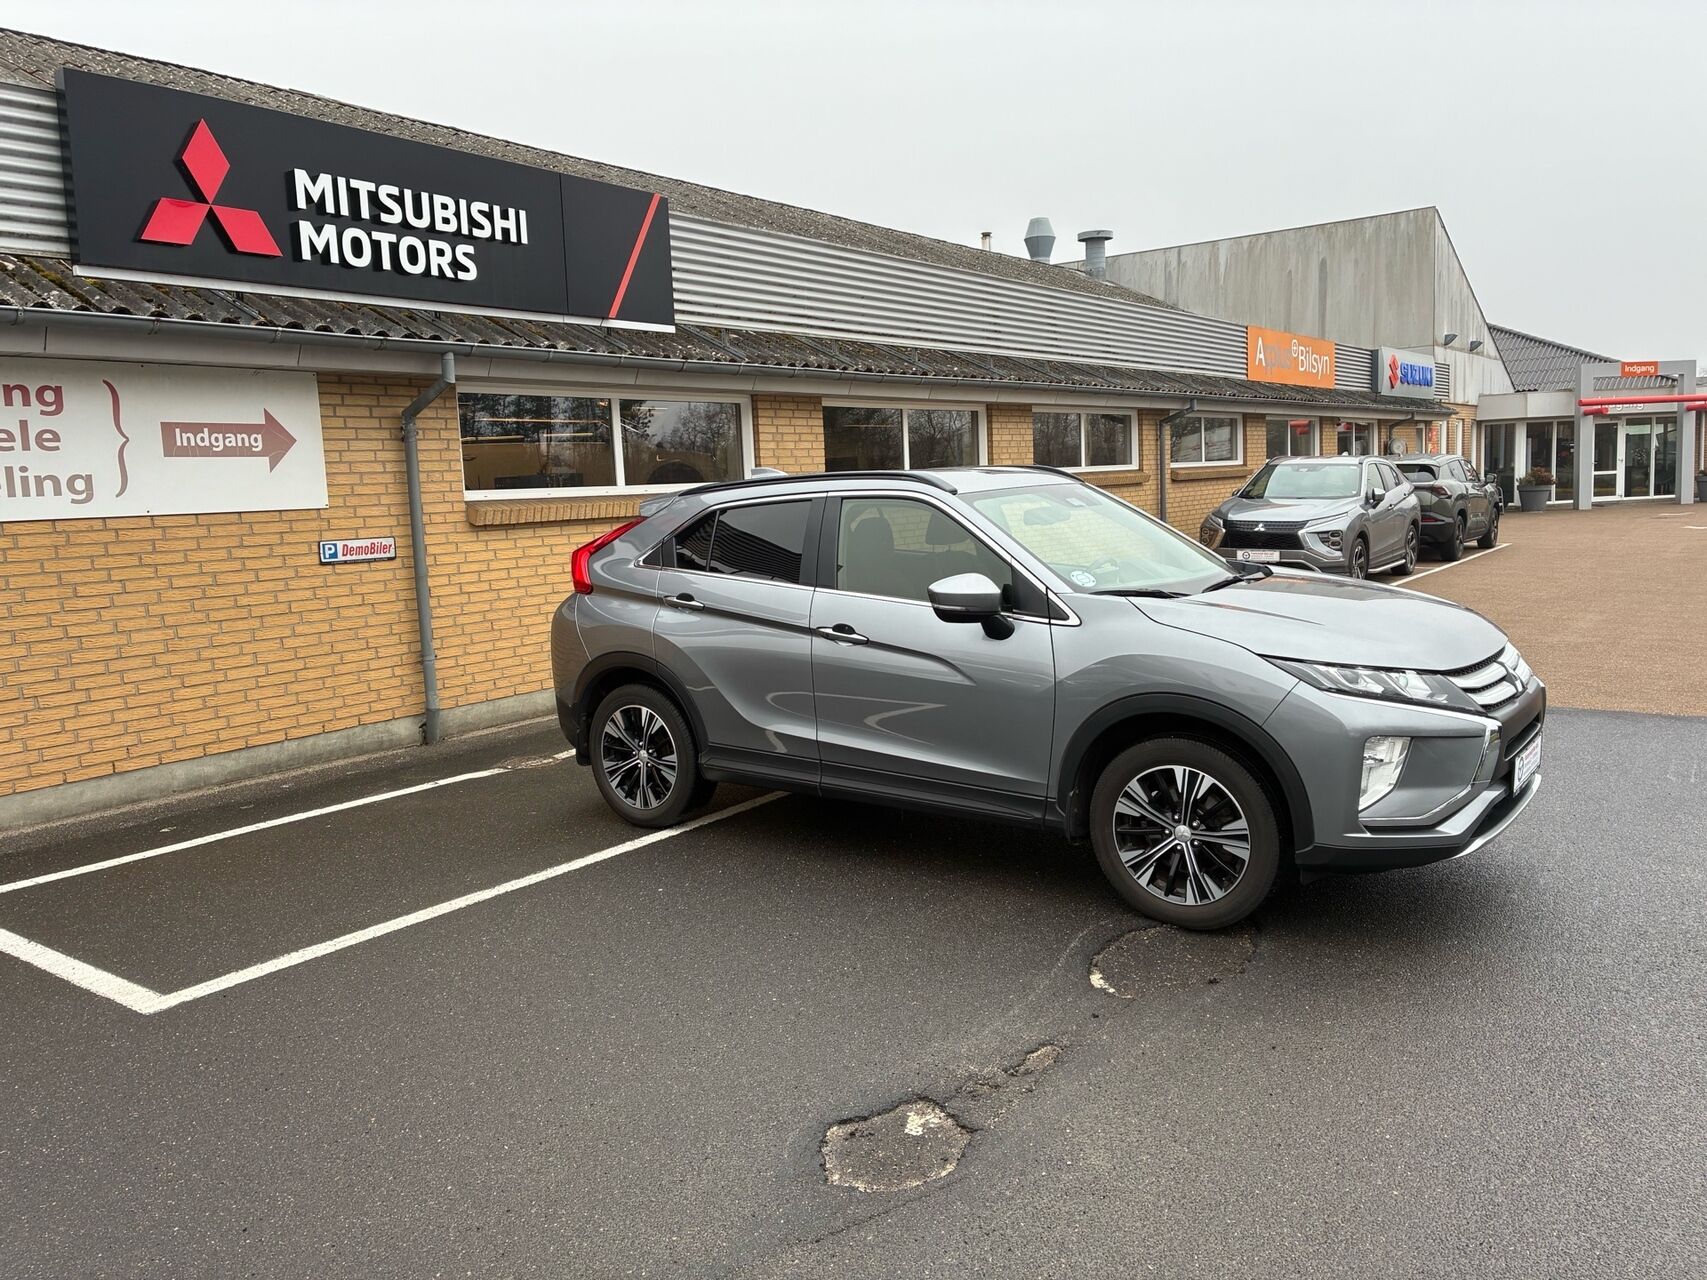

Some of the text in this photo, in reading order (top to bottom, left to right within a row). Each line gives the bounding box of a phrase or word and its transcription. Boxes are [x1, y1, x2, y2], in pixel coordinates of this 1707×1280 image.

[294, 168, 529, 244] MITSUBISHI
[298, 220, 478, 281] MOTORS
[1298, 345, 1330, 380] Bilsyn
[1400, 362, 1433, 387] SUZUKI
[1624, 364, 1656, 374] Indgang
[175, 428, 263, 451] Indgang
[0, 465, 95, 504] ling
[324, 541, 393, 559] P DemoBiler
